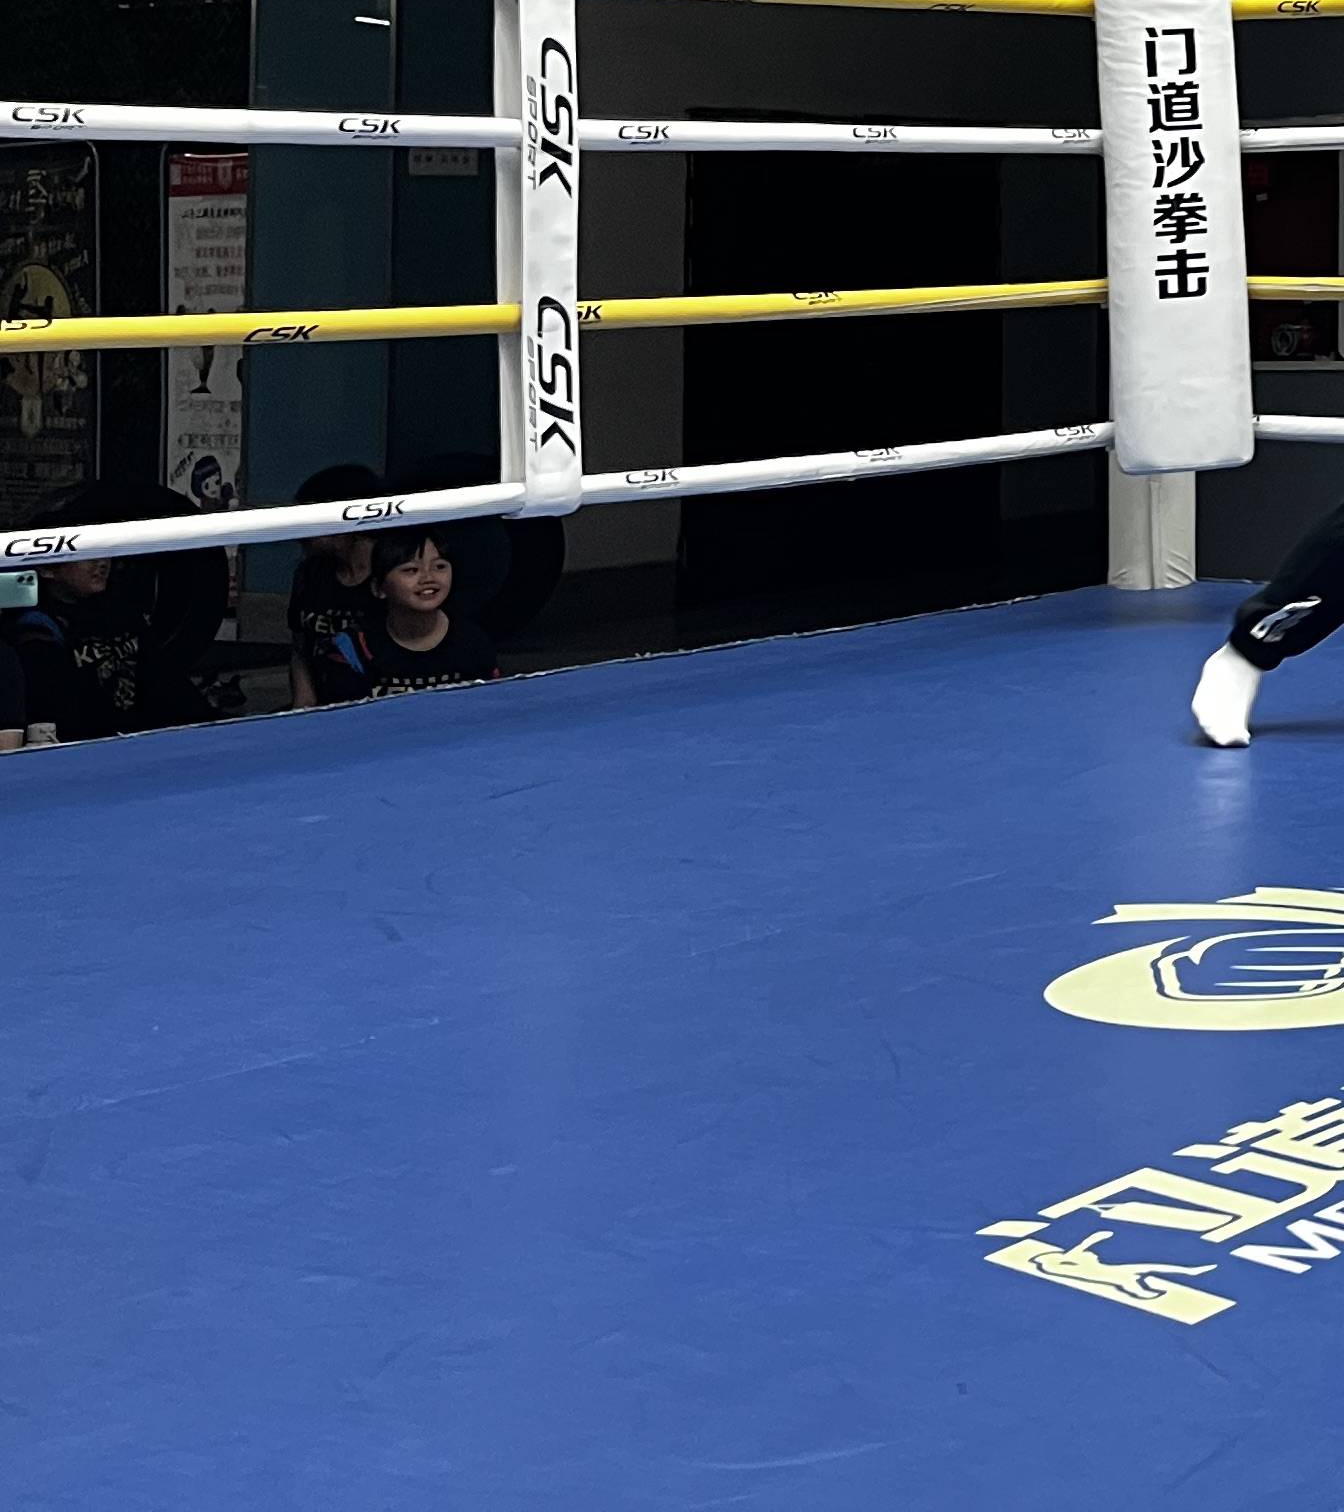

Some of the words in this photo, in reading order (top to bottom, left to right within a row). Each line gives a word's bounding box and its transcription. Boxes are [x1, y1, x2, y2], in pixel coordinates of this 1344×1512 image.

[1276, 0, 1321, 14] CSK
[11, 106, 86, 124] CSK
[539, 37, 573, 199] CSK
[338, 117, 402, 134] CSK
[526, 74, 537, 191] SPORT
[618, 125, 670, 139] CSK
[852, 127, 898, 138] CSK
[1144, 26, 1210, 300] 门道沙拳击
[243, 324, 320, 343] CSK
[538, 295, 577, 457] CSK
[526, 335, 539, 453] SPORT
[625, 468, 679, 484] CSK
[342, 499, 405, 521] CSK
[4, 534, 80, 557] CSK
